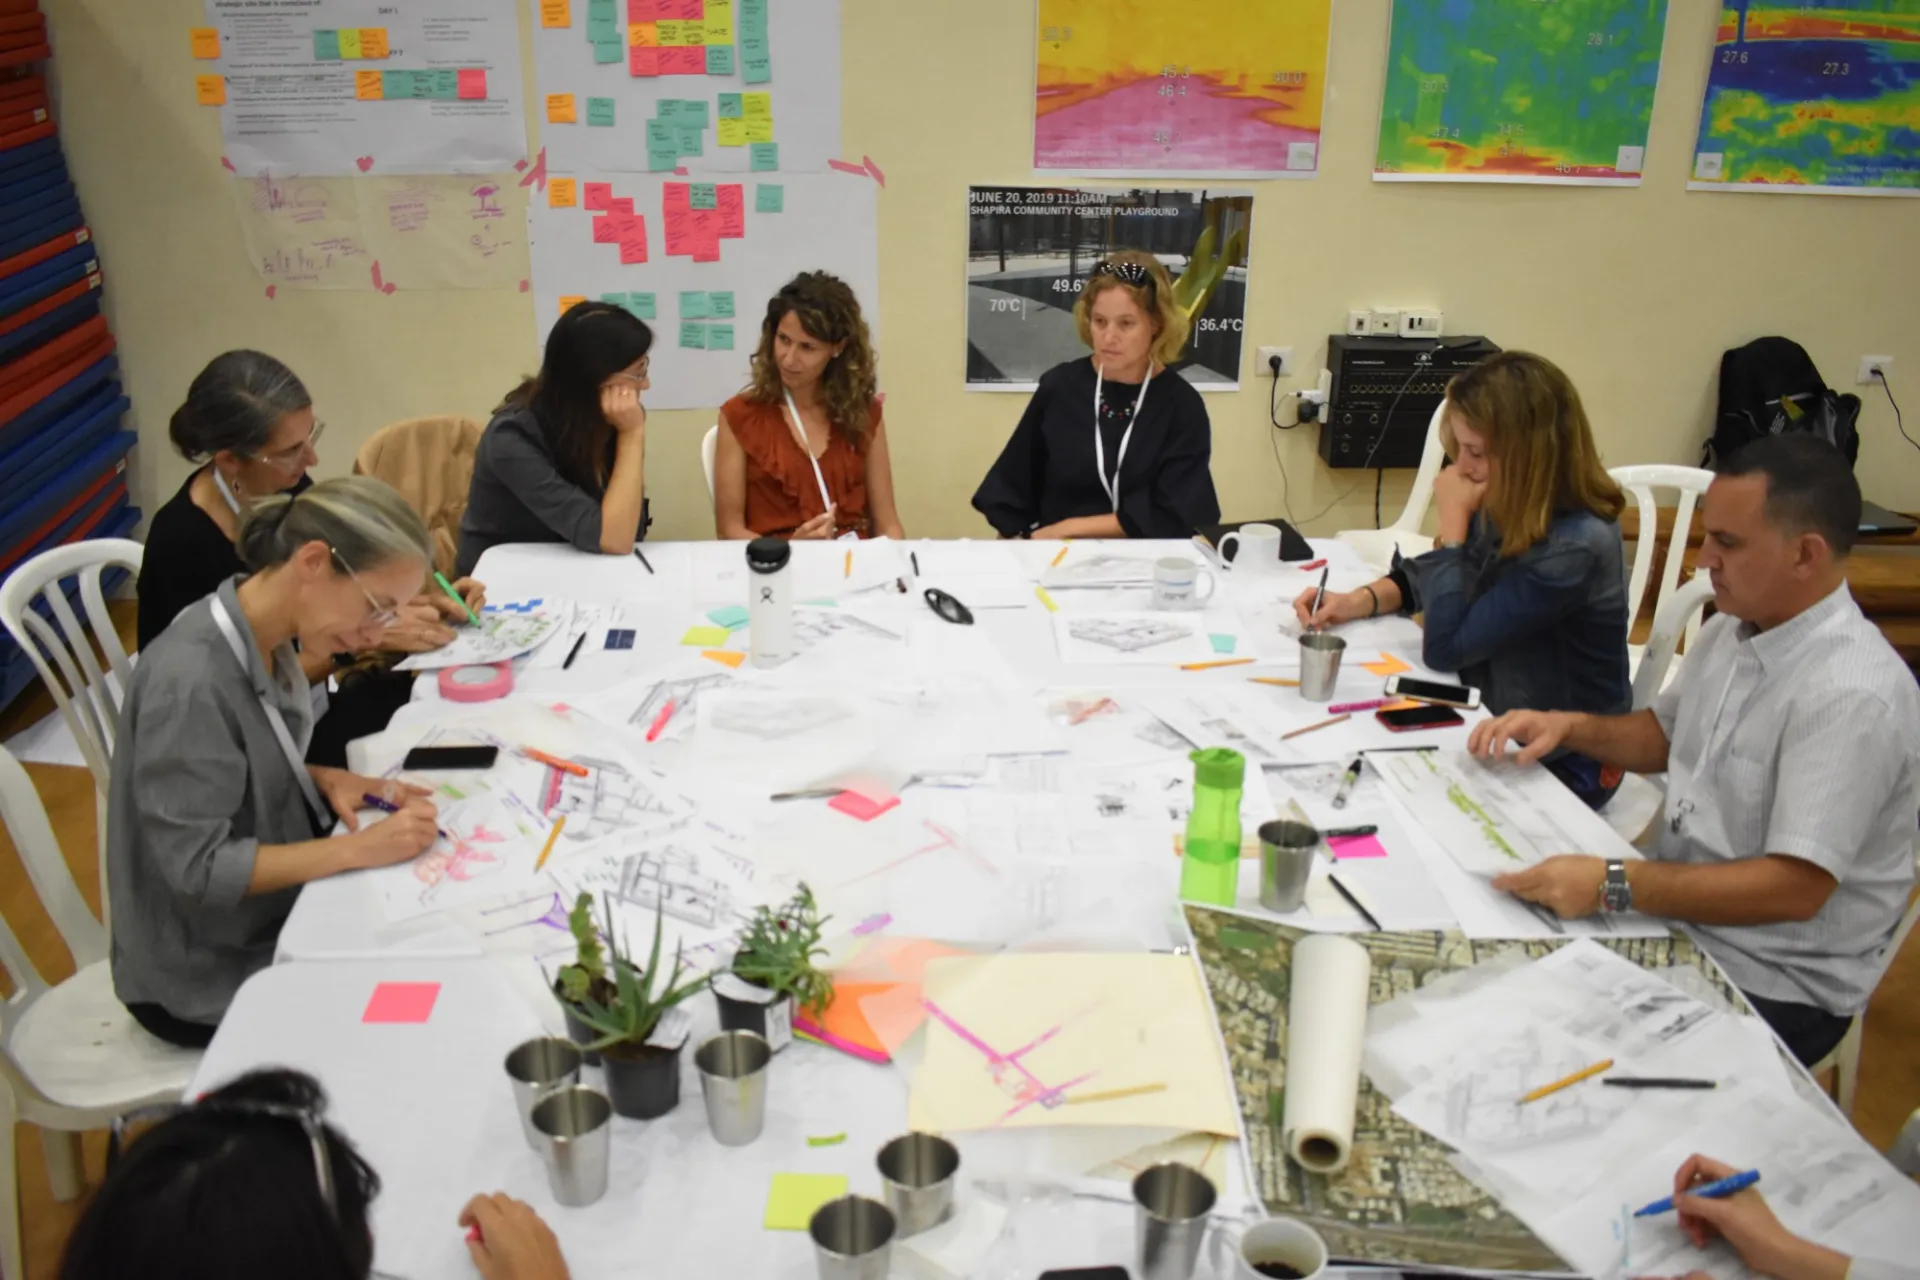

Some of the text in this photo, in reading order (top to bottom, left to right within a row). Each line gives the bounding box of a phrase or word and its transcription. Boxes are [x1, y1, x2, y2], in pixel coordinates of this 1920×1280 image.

[1586, 32, 1614, 47] 281
[1721, 50, 1749, 64] 27.6
[1160, 65, 1191, 79] 453
[1822, 62, 1850, 76] 27.3
[1273, 71, 1303, 84] 400
[1157, 85, 1187, 98] 464
[1420, 79, 1449, 93] 303
[970, 192, 1107, 205] JUNE 20, 2019 11:10AM
[970, 206, 1179, 217] SHAPIRA COMMUNITY CENTER PLAYGROUND
[1051, 278, 1086, 292] 49.6°
[989, 298, 1021, 312] 70°C
[1199, 317, 1243, 332] 36.4°C
